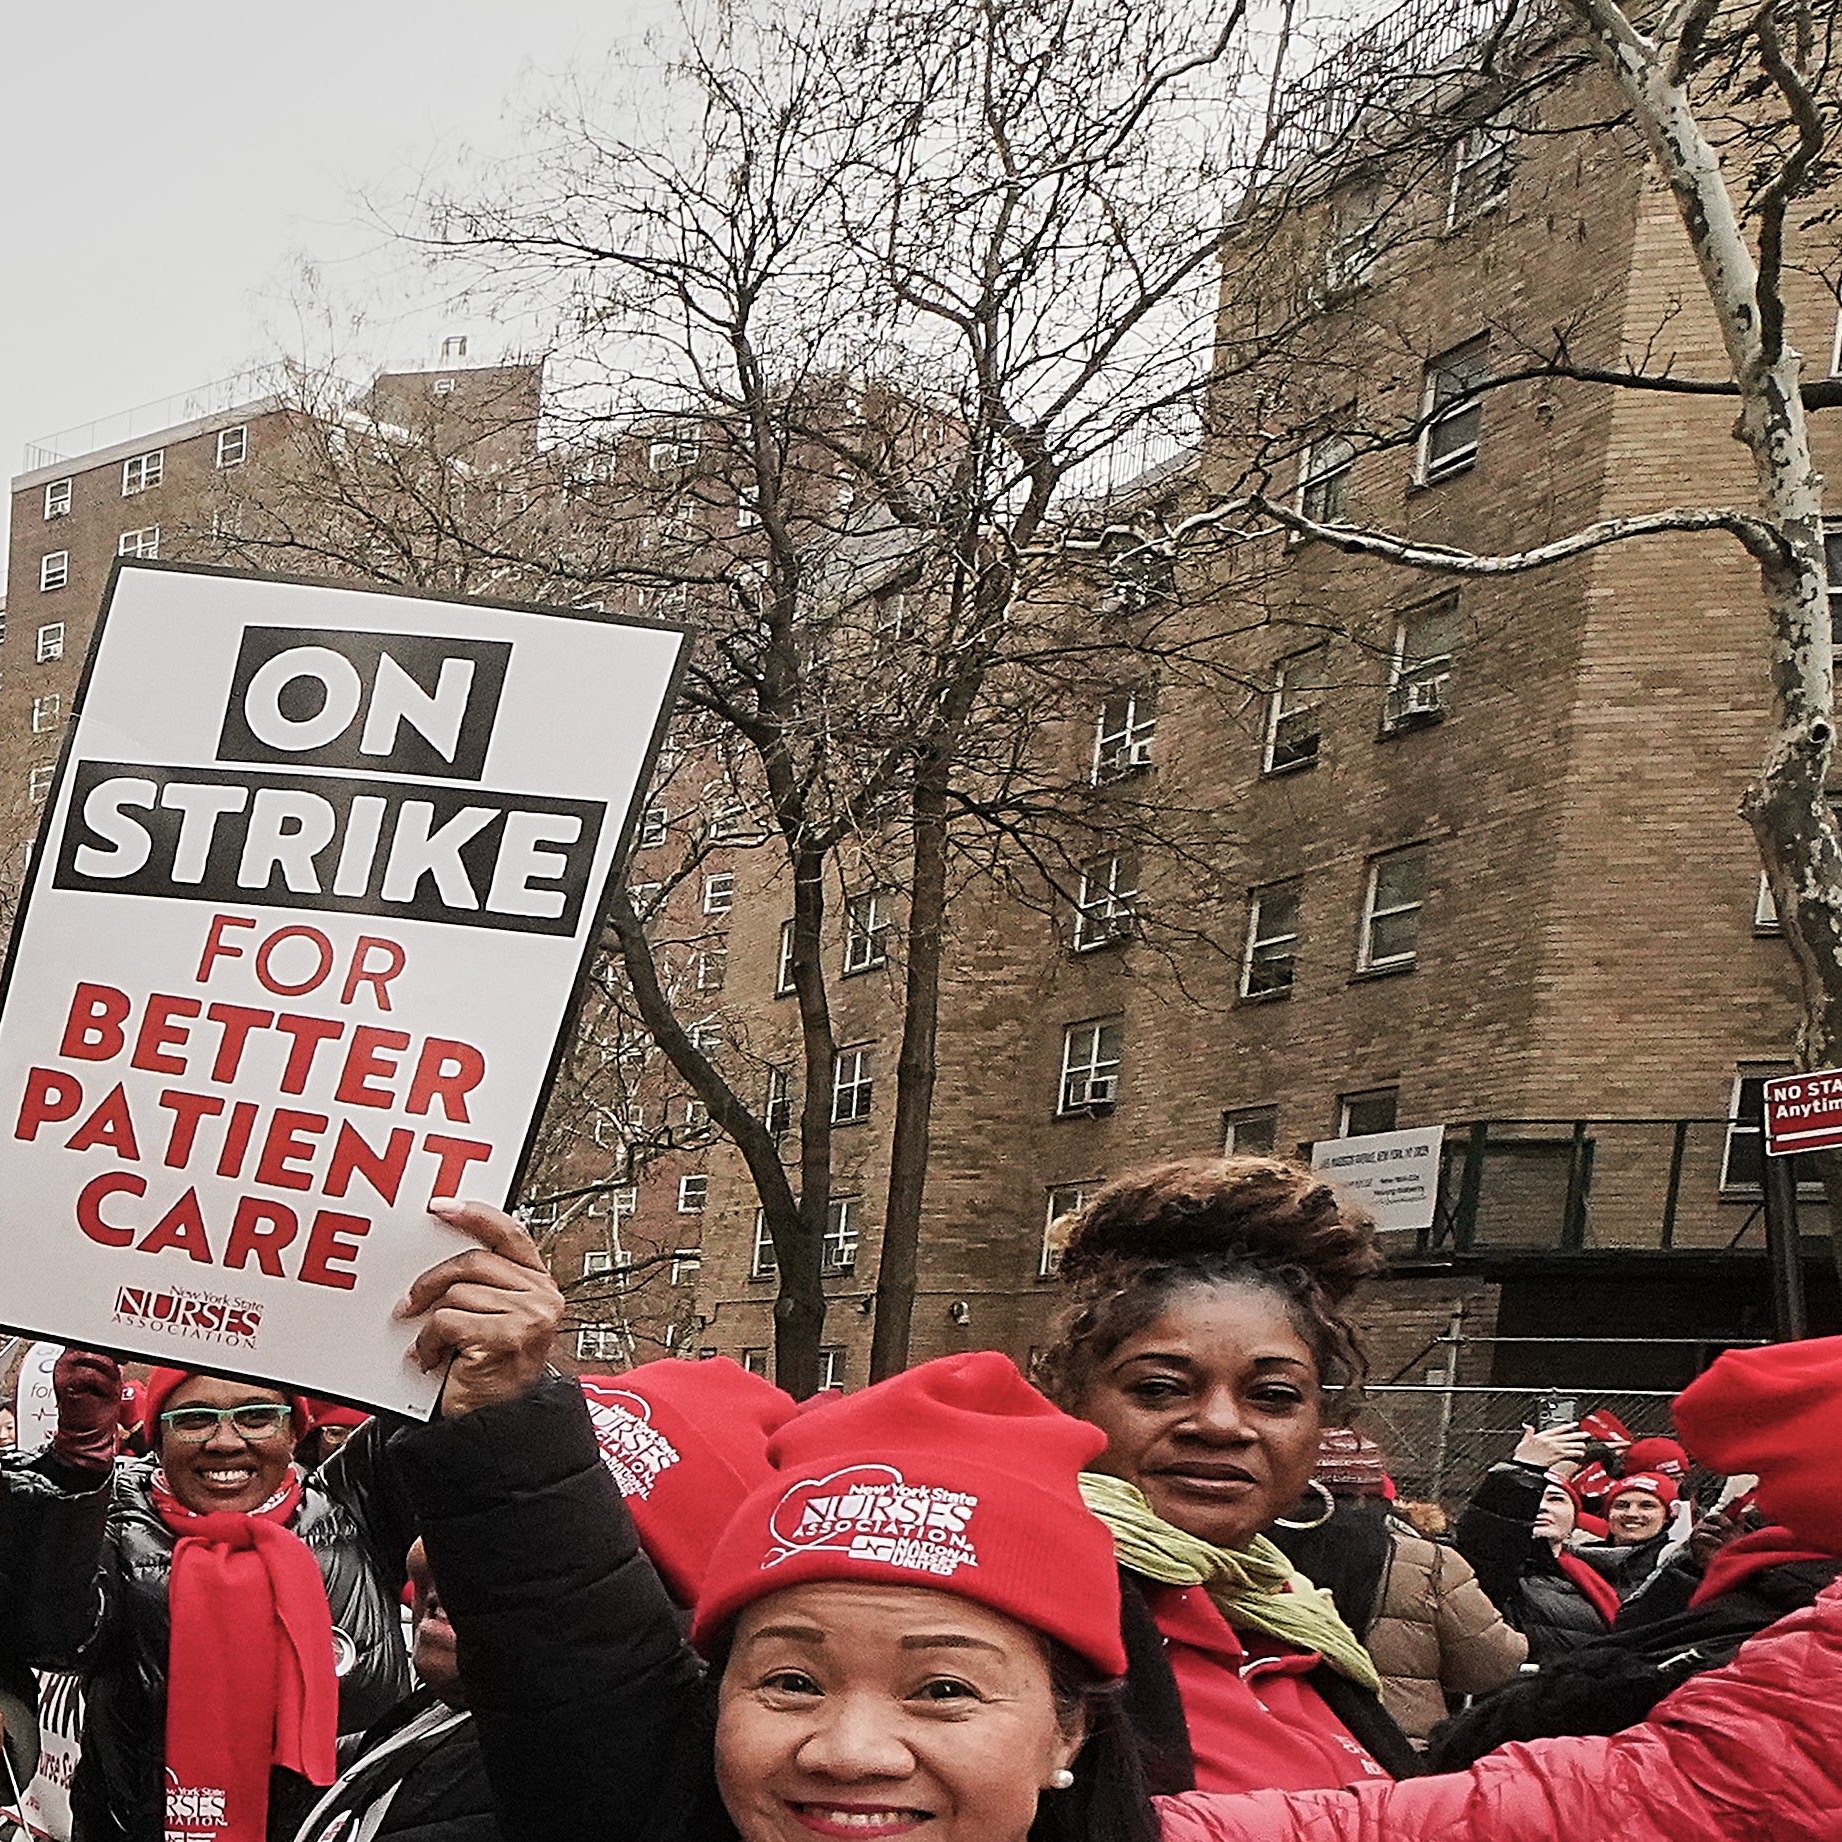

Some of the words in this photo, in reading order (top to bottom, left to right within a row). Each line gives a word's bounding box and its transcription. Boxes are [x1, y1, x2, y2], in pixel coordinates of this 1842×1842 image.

[244, 645, 476, 764] ON
[74, 777, 581, 920] STRIKE
[196, 914, 407, 1010] FOR
[58, 982, 486, 1124] BETTER
[1774, 1086, 1802, 1101] NO
[14, 1067, 493, 1213] PATIENT
[77, 1172, 371, 1291] CARE
[115, 1286, 262, 1337] NURSES
[170, 1285, 202, 1300] New
[203, 1291, 230, 1305] York
[231, 1297, 264, 1311] State
[111, 1313, 257, 1350] ASSOCIATION
[849, 1485, 892, 1496] New
[891, 1483, 930, 1500] York
[930, 1488, 978, 1506] State
[802, 1495, 973, 1532] NURSES
[891, 1554, 953, 1576] UNITED
[896, 1537, 978, 1567] NATIONAL
[896, 1546, 957, 1568] NURSES
[167, 1795, 225, 1817] RSES
